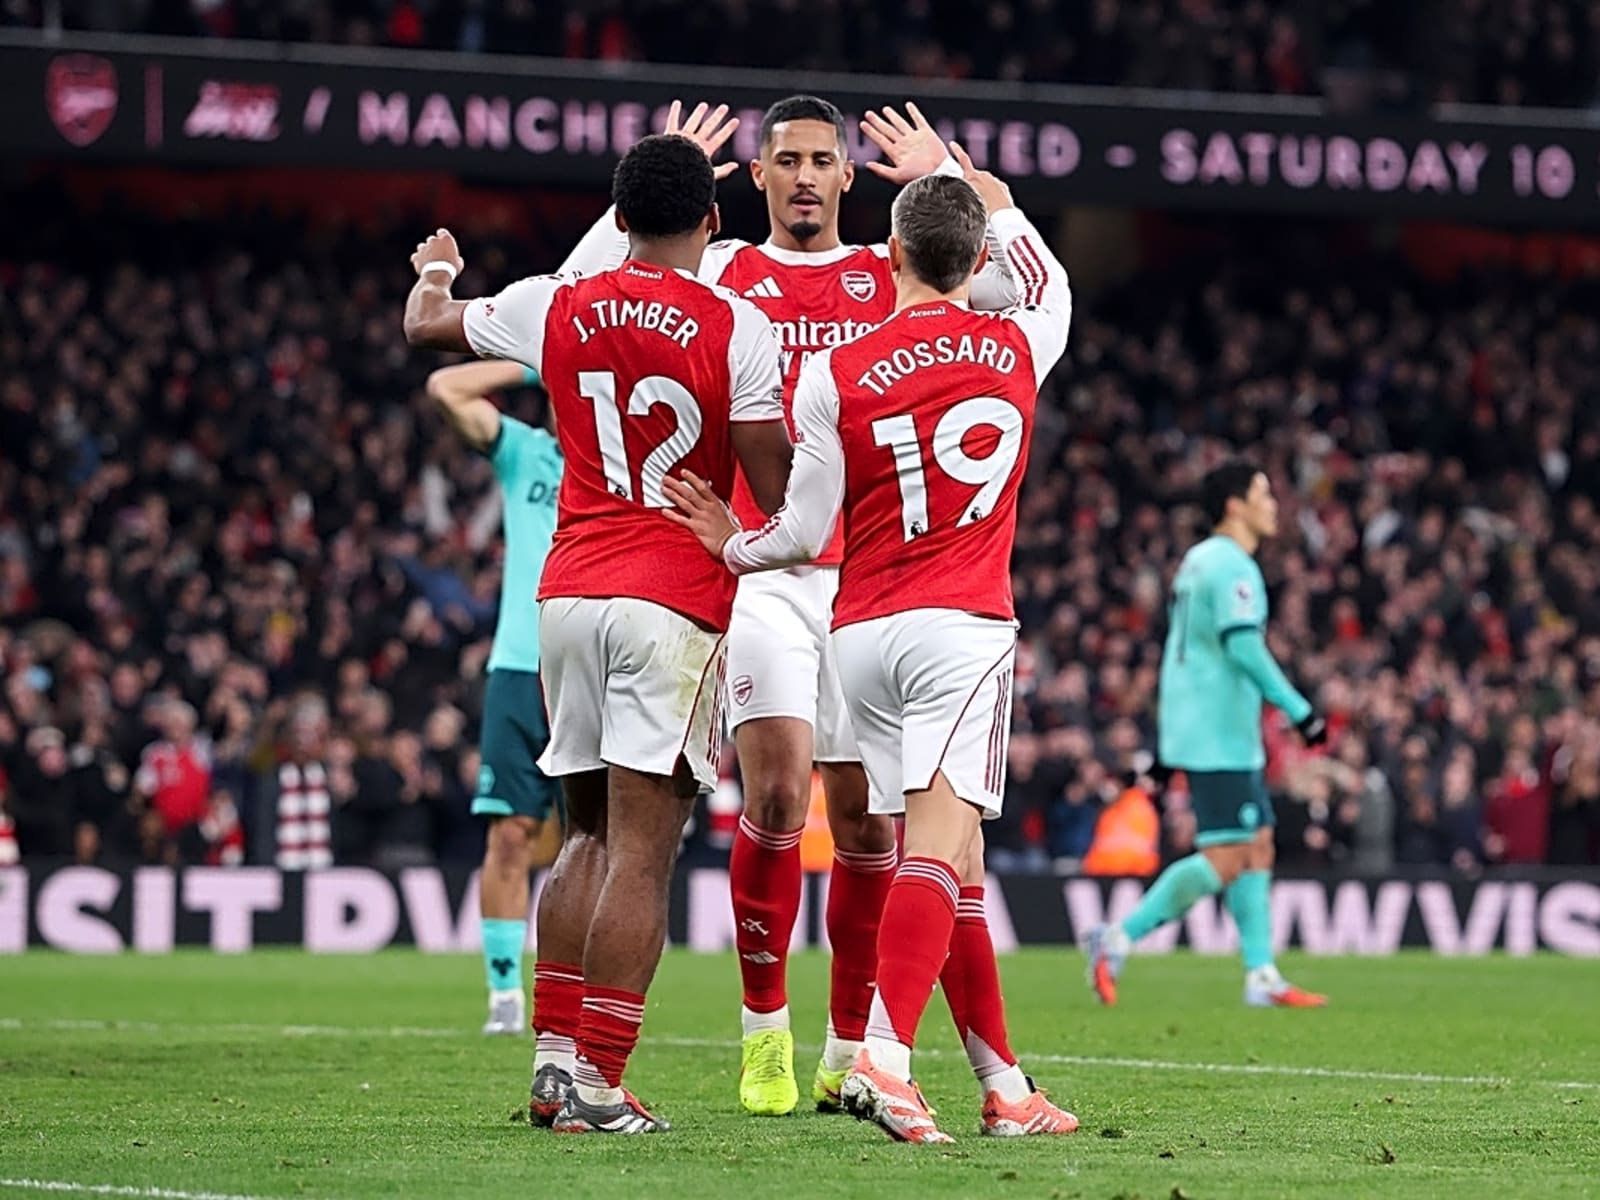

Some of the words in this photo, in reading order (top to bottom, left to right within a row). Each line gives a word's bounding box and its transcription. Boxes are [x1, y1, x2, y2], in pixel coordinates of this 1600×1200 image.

[357, 91, 764, 163] MANCHEE
[1161, 128, 1488, 195] SATURDAY
[1511, 144, 1575, 199] 10
[624, 266, 663, 280] Arsenal
[770, 315, 881, 347] mirate
[908, 306, 946, 318] Arsenal
[857, 335, 1016, 396] TROSSARD
[578, 371, 703, 508] 12
[871, 397, 1024, 544] 19
